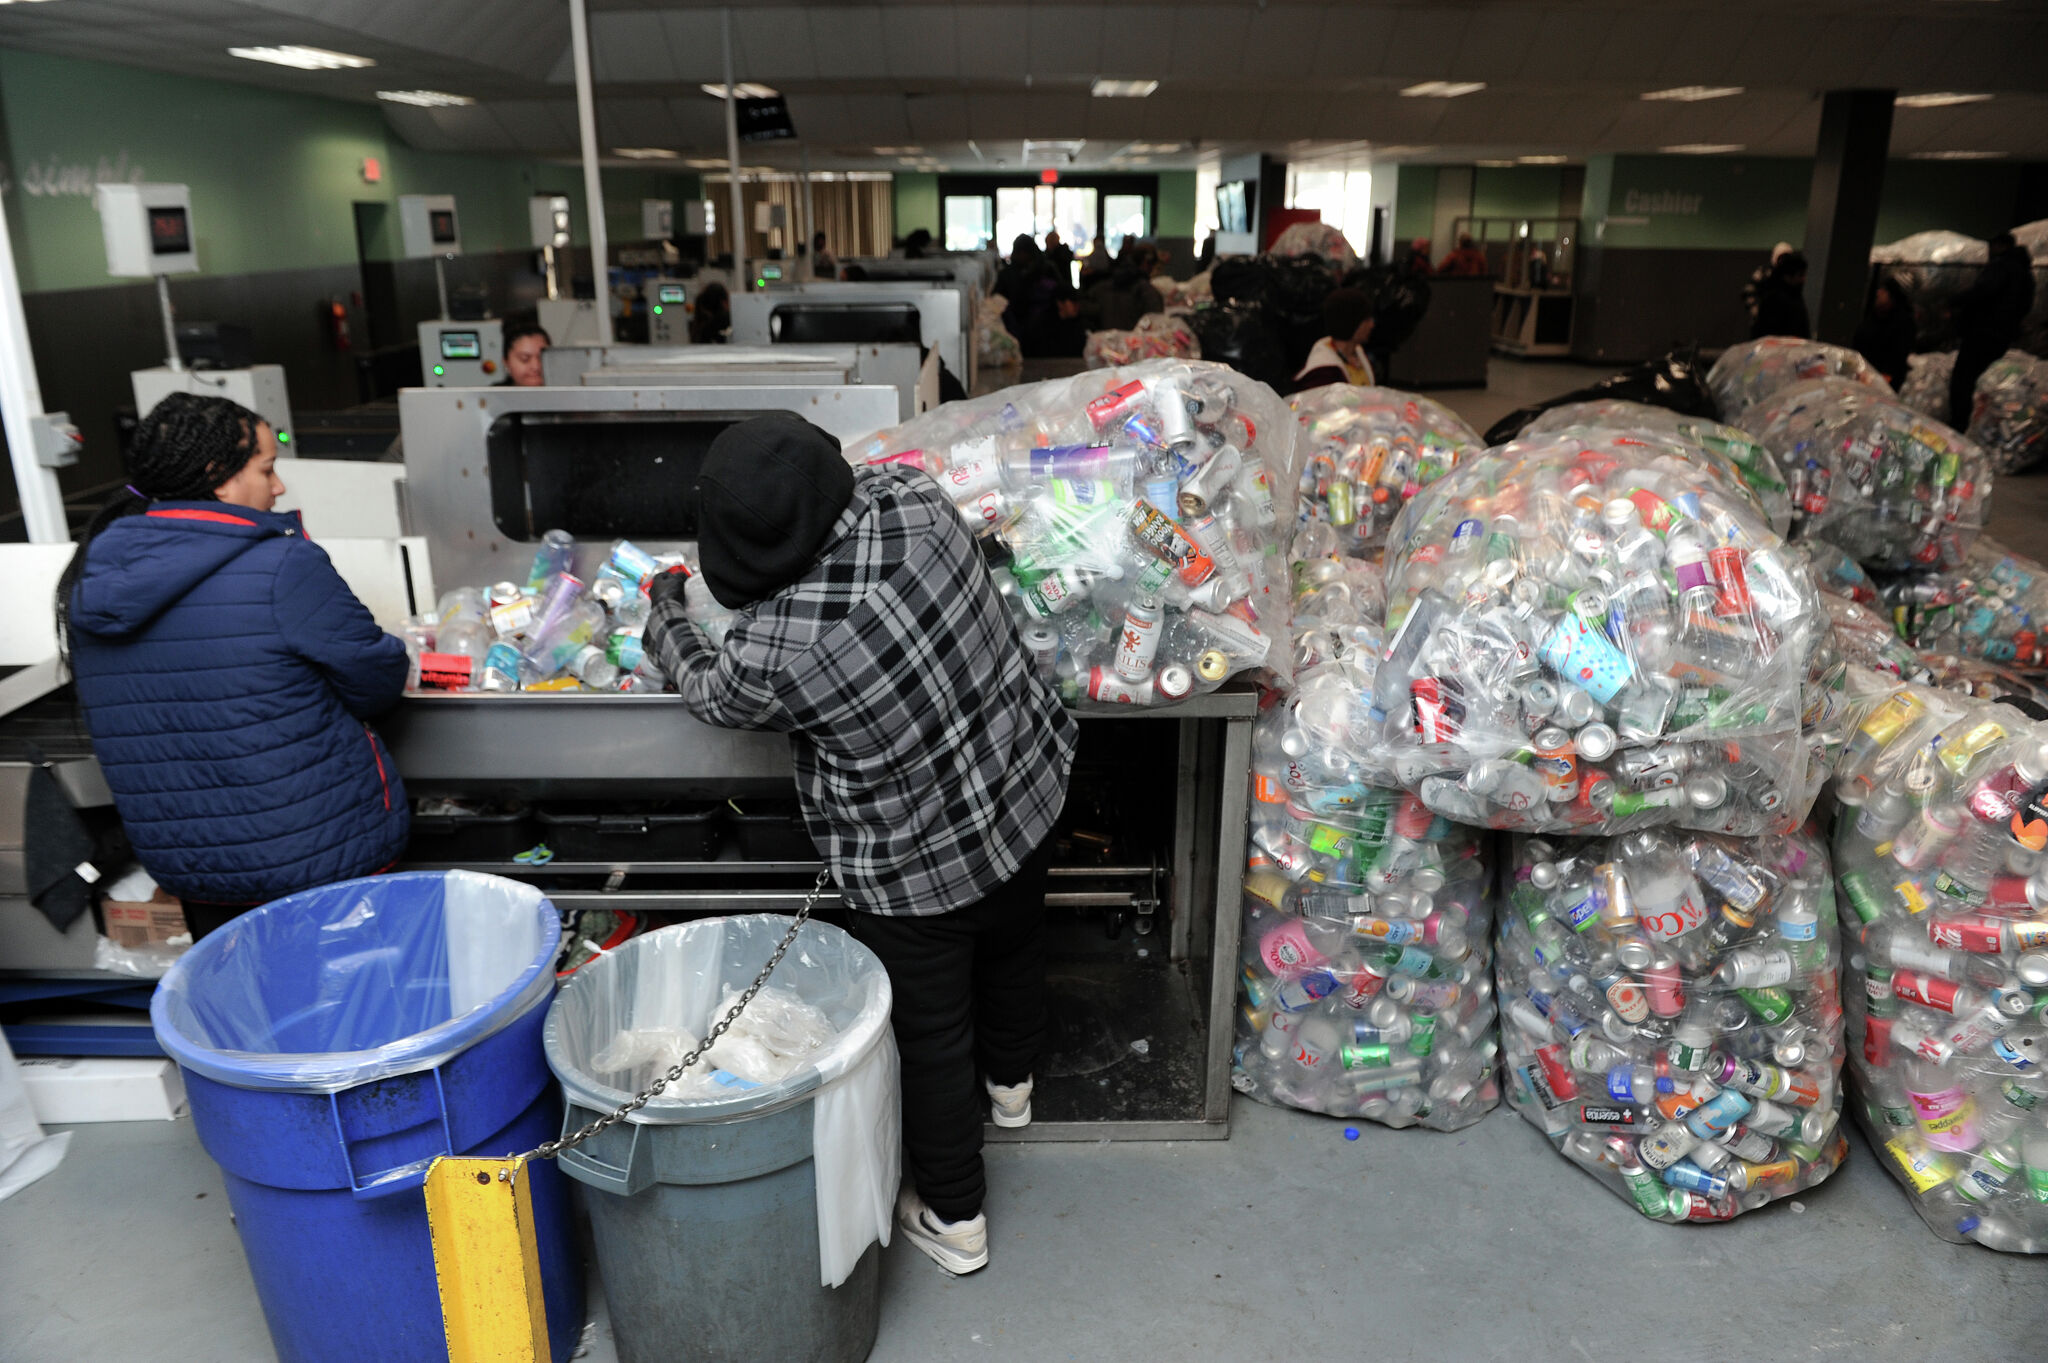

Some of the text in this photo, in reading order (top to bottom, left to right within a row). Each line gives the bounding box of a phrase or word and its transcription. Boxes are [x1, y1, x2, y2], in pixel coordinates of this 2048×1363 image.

[1624, 188, 1703, 215] Cashier
[1132, 508, 1148, 528] IPA
[1585, 1111, 1621, 1121] essentia
